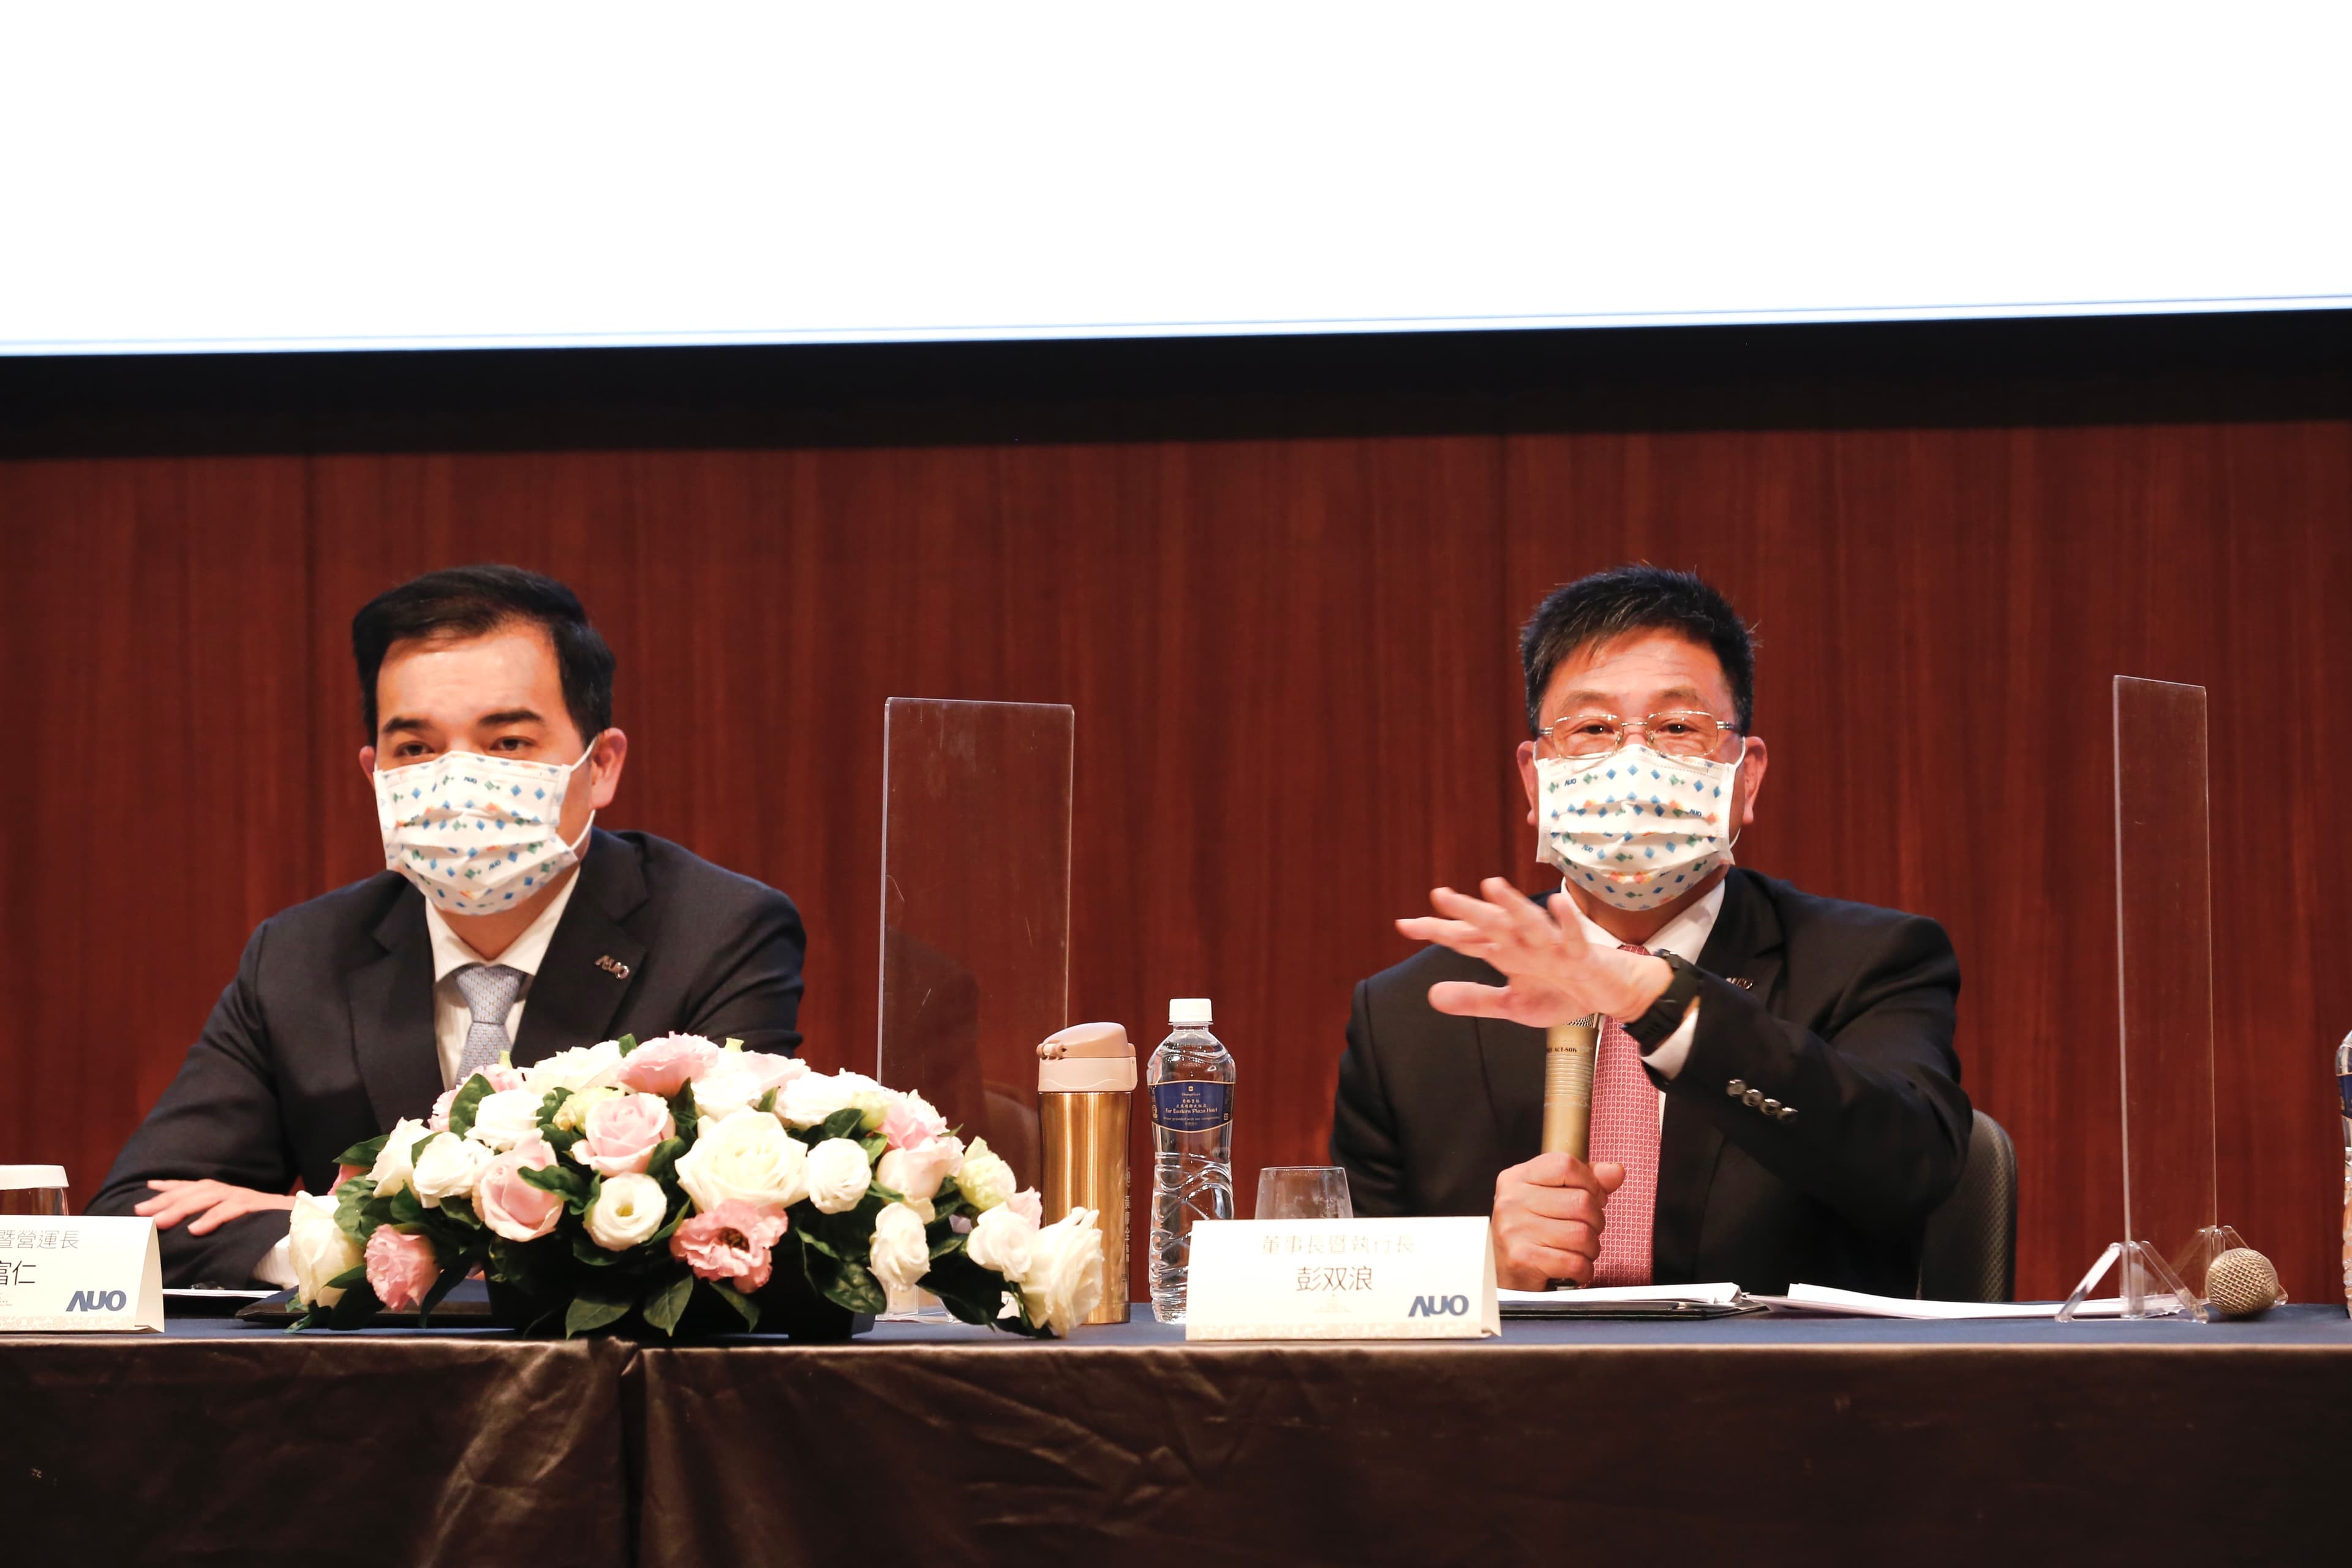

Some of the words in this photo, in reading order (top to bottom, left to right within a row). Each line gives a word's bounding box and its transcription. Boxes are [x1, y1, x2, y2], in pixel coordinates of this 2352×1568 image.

[1564, 778, 1577, 786] AUO
[1296, 1265, 1373, 1291] 彭双浪
[66, 1290, 127, 1311] AUO
[1408, 1294, 1469, 1317] AUO
